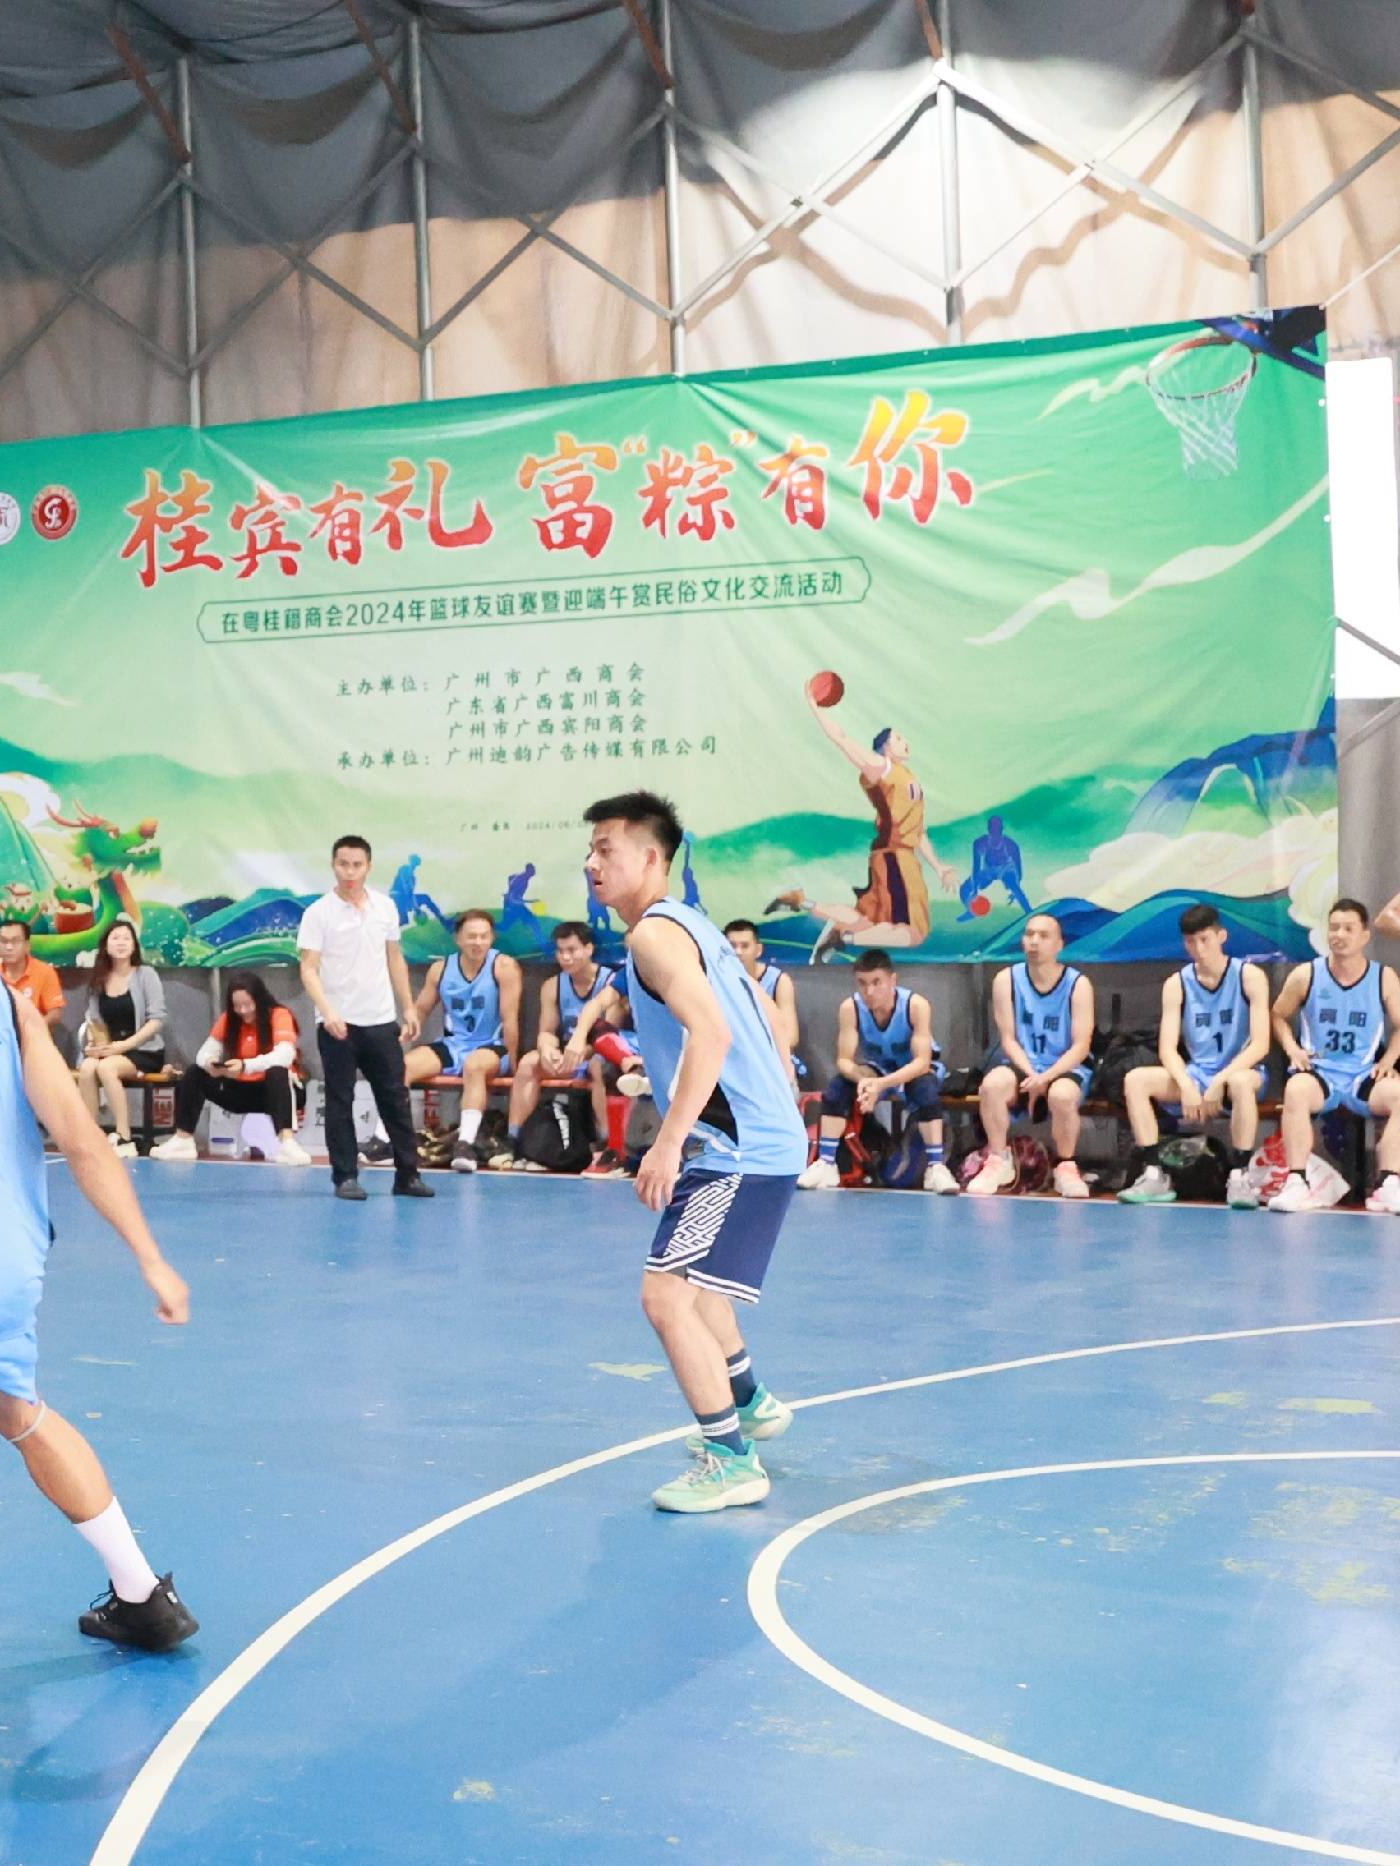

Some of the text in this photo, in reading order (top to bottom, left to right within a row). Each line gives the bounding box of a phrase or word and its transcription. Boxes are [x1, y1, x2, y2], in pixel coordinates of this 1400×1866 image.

[121, 459, 493, 587] 桂宾有礼
[445, 661, 645, 691] 广州市广西商会
[447, 687, 646, 716] 广东省广西富川商会
[449, 713, 647, 739] 广州市广西宾阳商会
[1212, 1031, 1223, 1053] 1
[1325, 1029, 1355, 1054] 33
